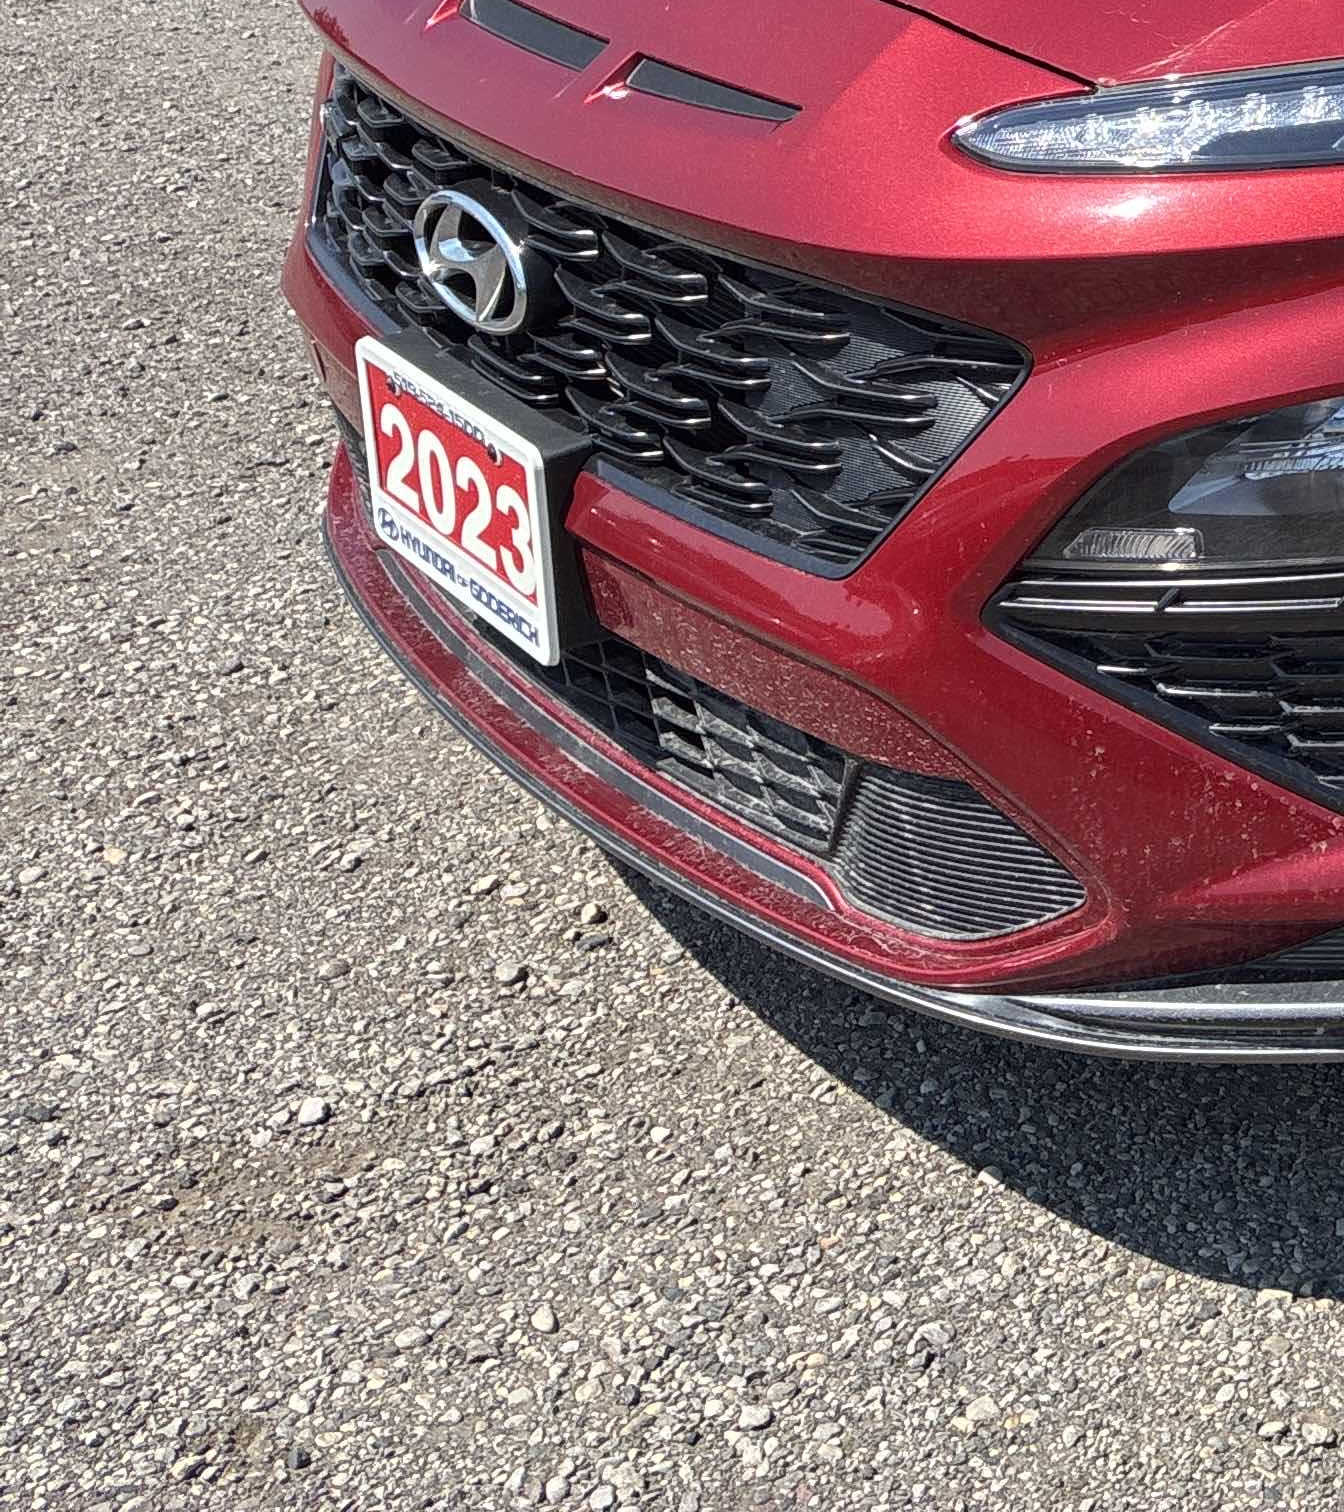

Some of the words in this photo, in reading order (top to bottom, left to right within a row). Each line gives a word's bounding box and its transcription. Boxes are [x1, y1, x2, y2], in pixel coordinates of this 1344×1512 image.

[379, 402, 537, 596] 2023
[400, 525, 457, 584] HYUNDAI
[469, 577, 539, 647] GODERICH
